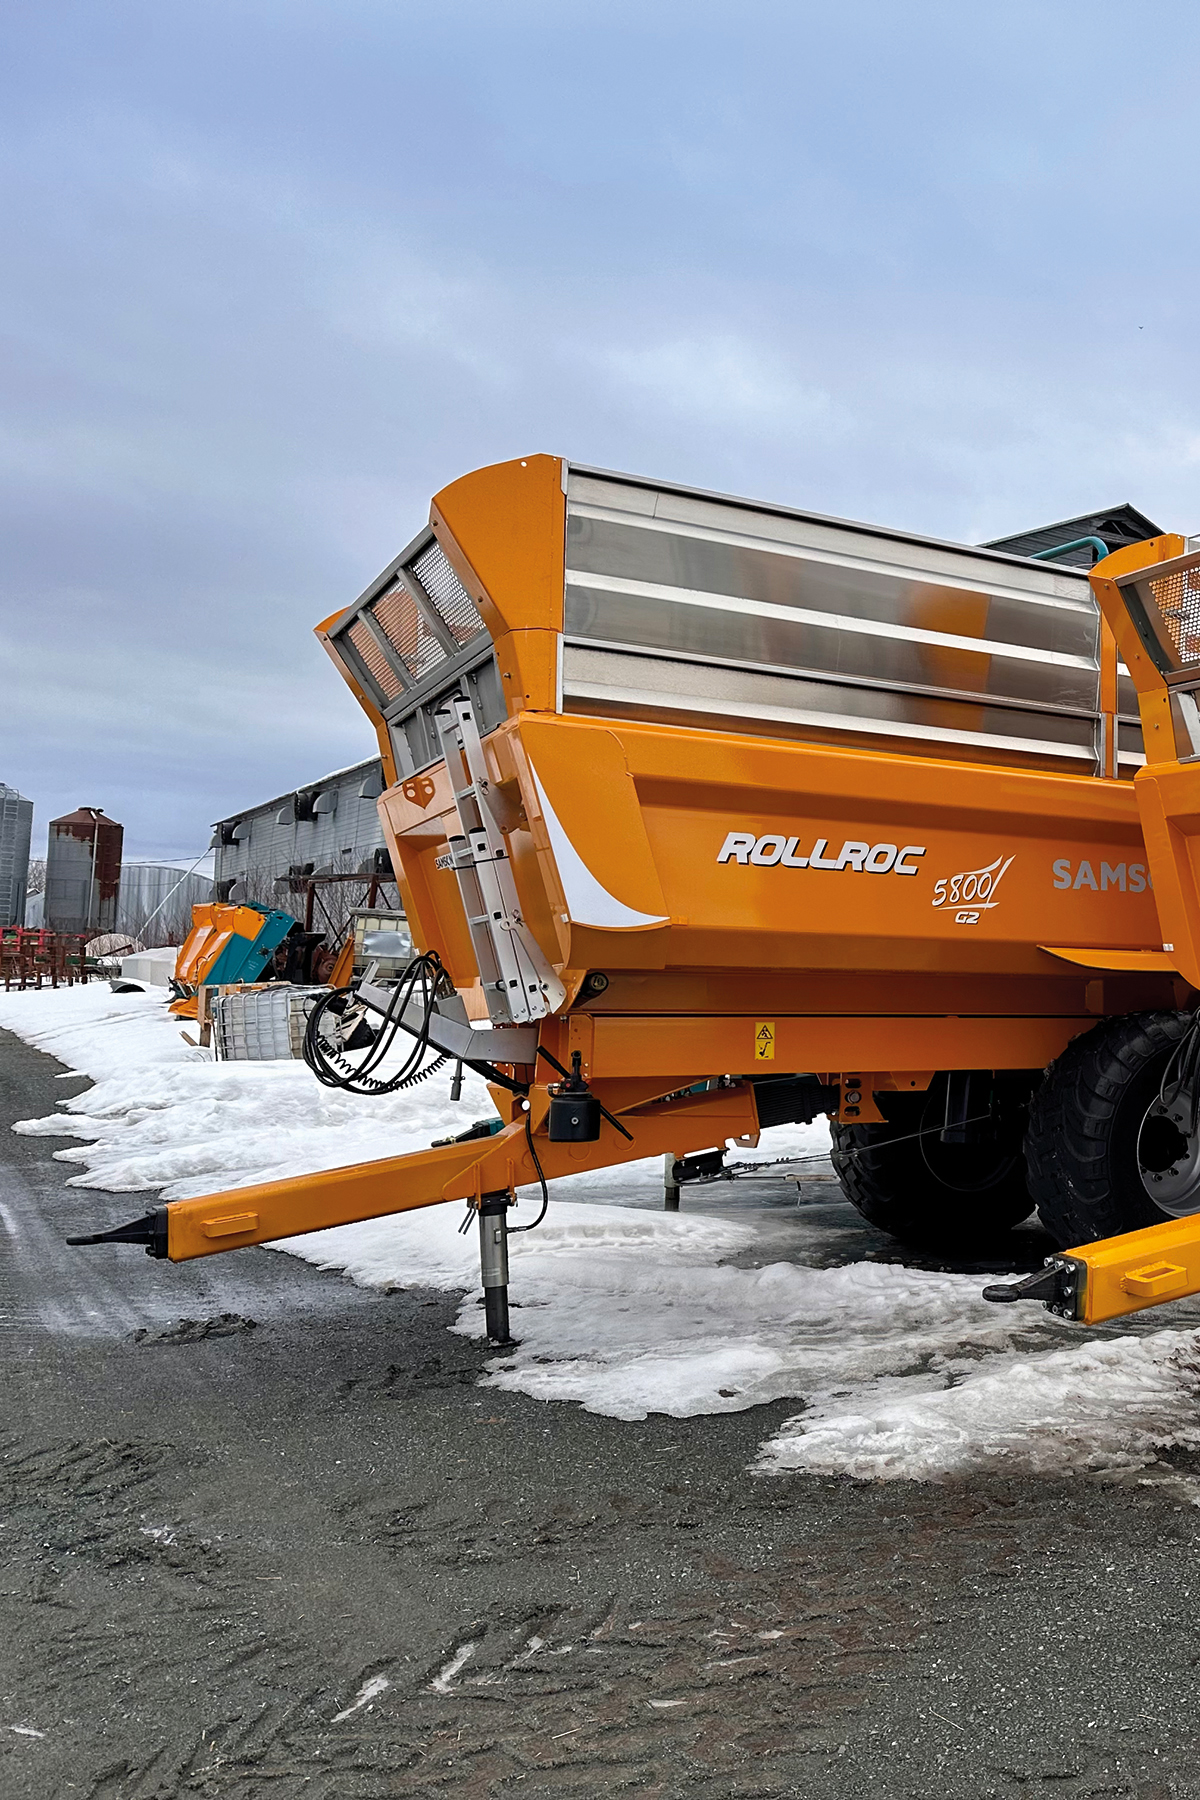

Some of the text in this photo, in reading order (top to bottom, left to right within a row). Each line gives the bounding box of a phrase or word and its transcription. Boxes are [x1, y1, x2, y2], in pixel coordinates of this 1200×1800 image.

[717, 832, 927, 876] ROLLROC
[931, 872, 993, 907] 5800
[1052, 859, 1155, 893] SAMS
[954, 911, 981, 925] G2
